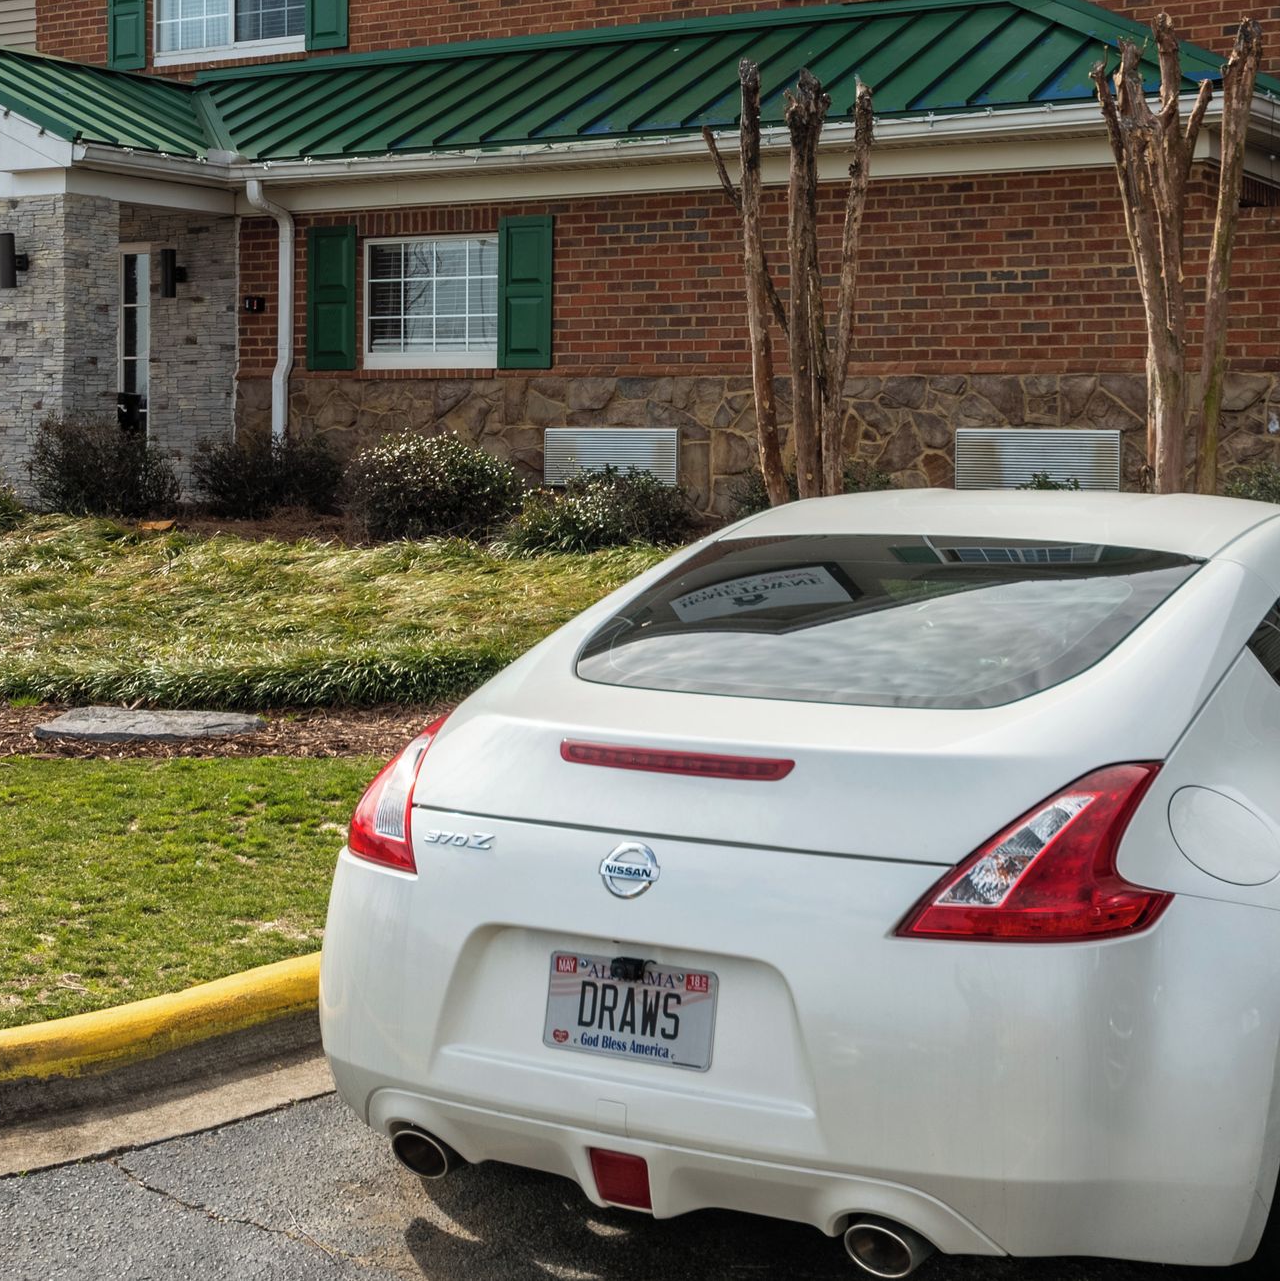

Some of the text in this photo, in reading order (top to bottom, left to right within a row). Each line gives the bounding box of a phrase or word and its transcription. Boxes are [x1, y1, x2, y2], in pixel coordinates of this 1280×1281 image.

[423, 829, 496, 851] 370Z
[604, 863, 652, 878] NISSAN
[557, 958, 576, 973] MAY
[587, 962, 676, 989] ALMA
[689, 974, 700, 987] 18
[577, 980, 682, 1041] DRAWS
[580, 1031, 599, 1047] God
[601, 1034, 627, 1052] Bless
[629, 1041, 669, 1059] America
